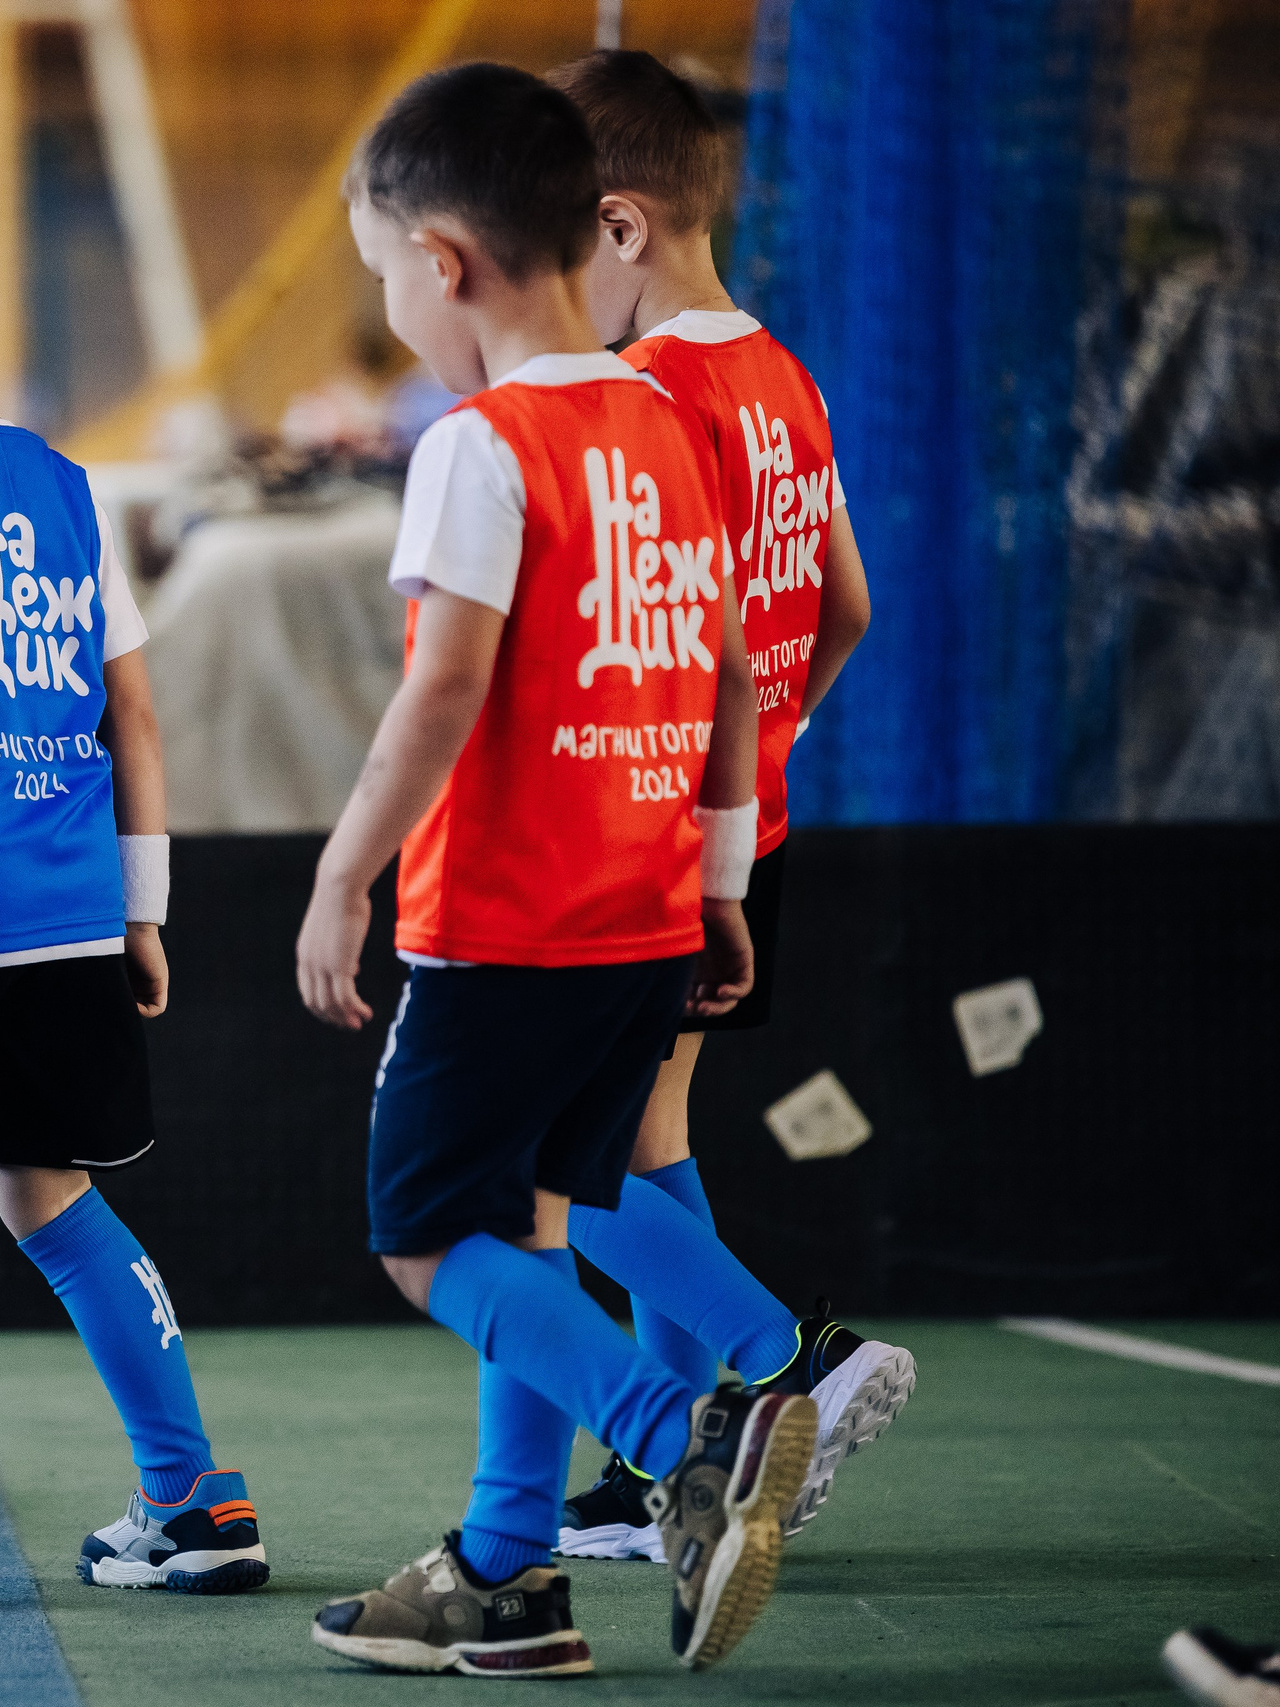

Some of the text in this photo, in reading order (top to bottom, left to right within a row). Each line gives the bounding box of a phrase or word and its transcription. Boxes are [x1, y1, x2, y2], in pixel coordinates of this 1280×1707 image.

[756, 679, 790, 713] 2024
[14, 770, 70, 801] 2024
[630, 765, 690, 802] 2024
[501, 1599, 521, 1616] 23
